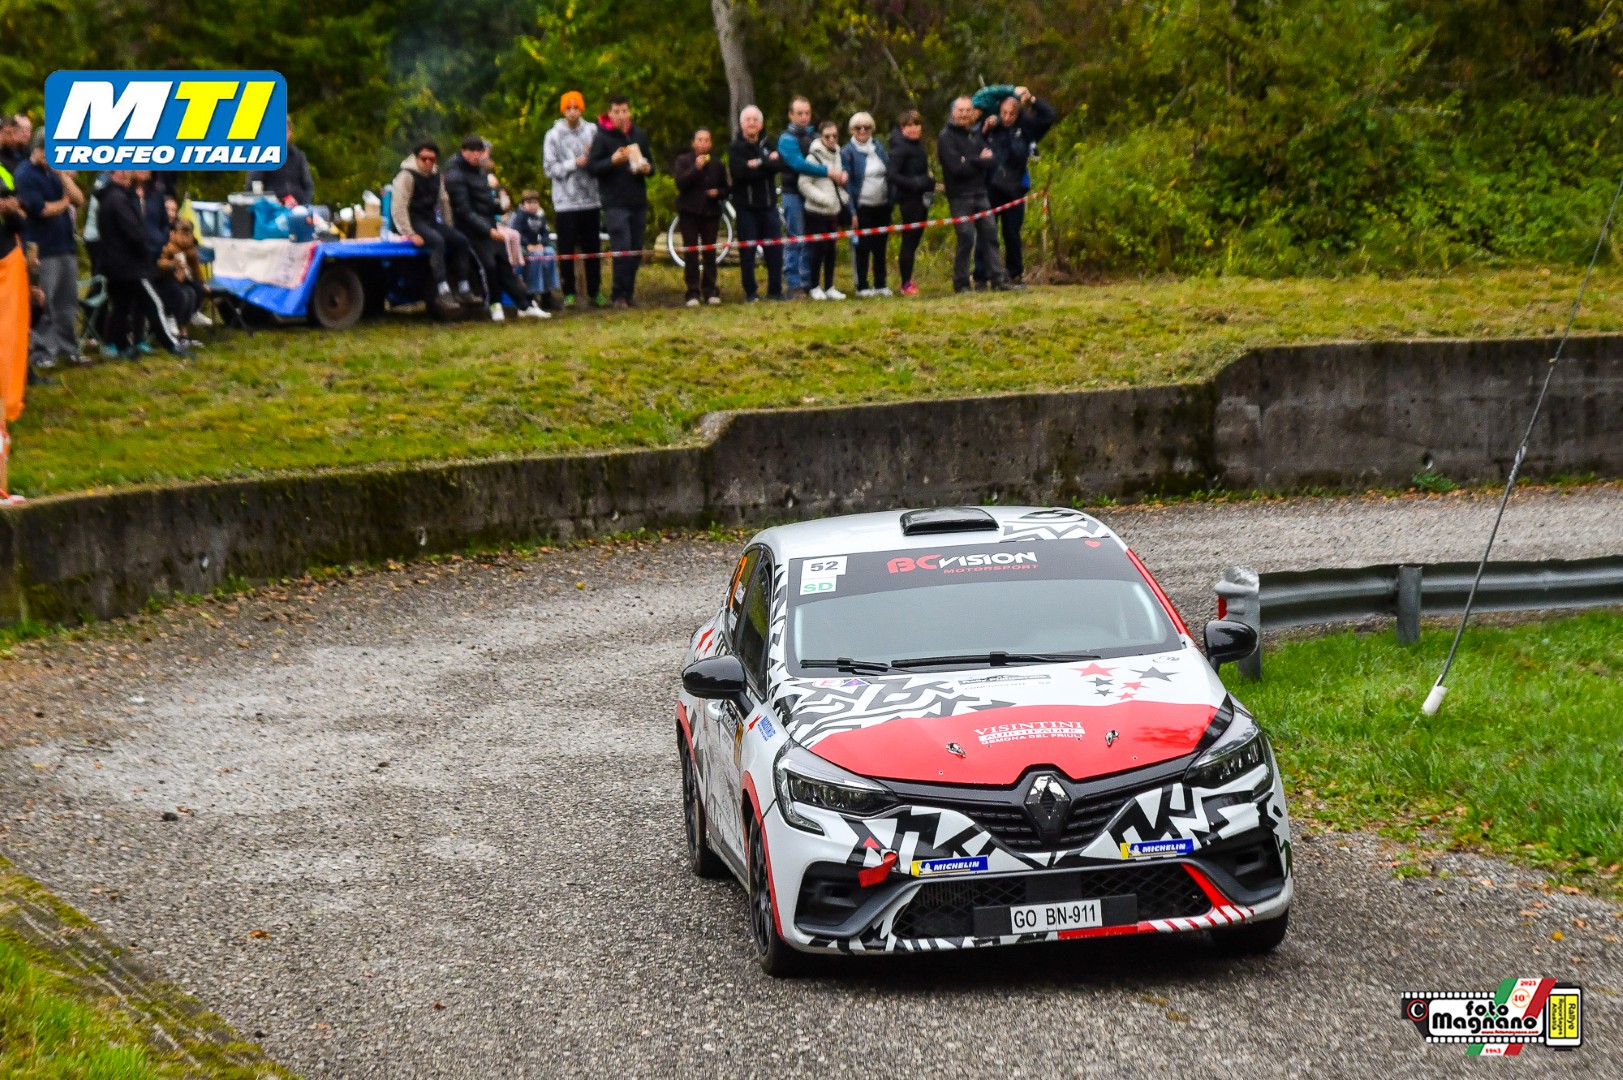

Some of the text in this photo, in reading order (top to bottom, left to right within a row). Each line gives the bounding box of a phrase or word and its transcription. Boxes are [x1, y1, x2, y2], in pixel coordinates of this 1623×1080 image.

[810, 561, 839, 572] 52
[943, 564, 1039, 574] MOTORSPORT
[803, 582, 834, 593] SD
[973, 721, 1083, 735] VISINTINI
[981, 735, 1027, 745] GEMONA
[1142, 843, 1186, 853] MICHELIN
[933, 861, 980, 871] MICHELIN
[1013, 903, 1096, 928] GO BN-911
